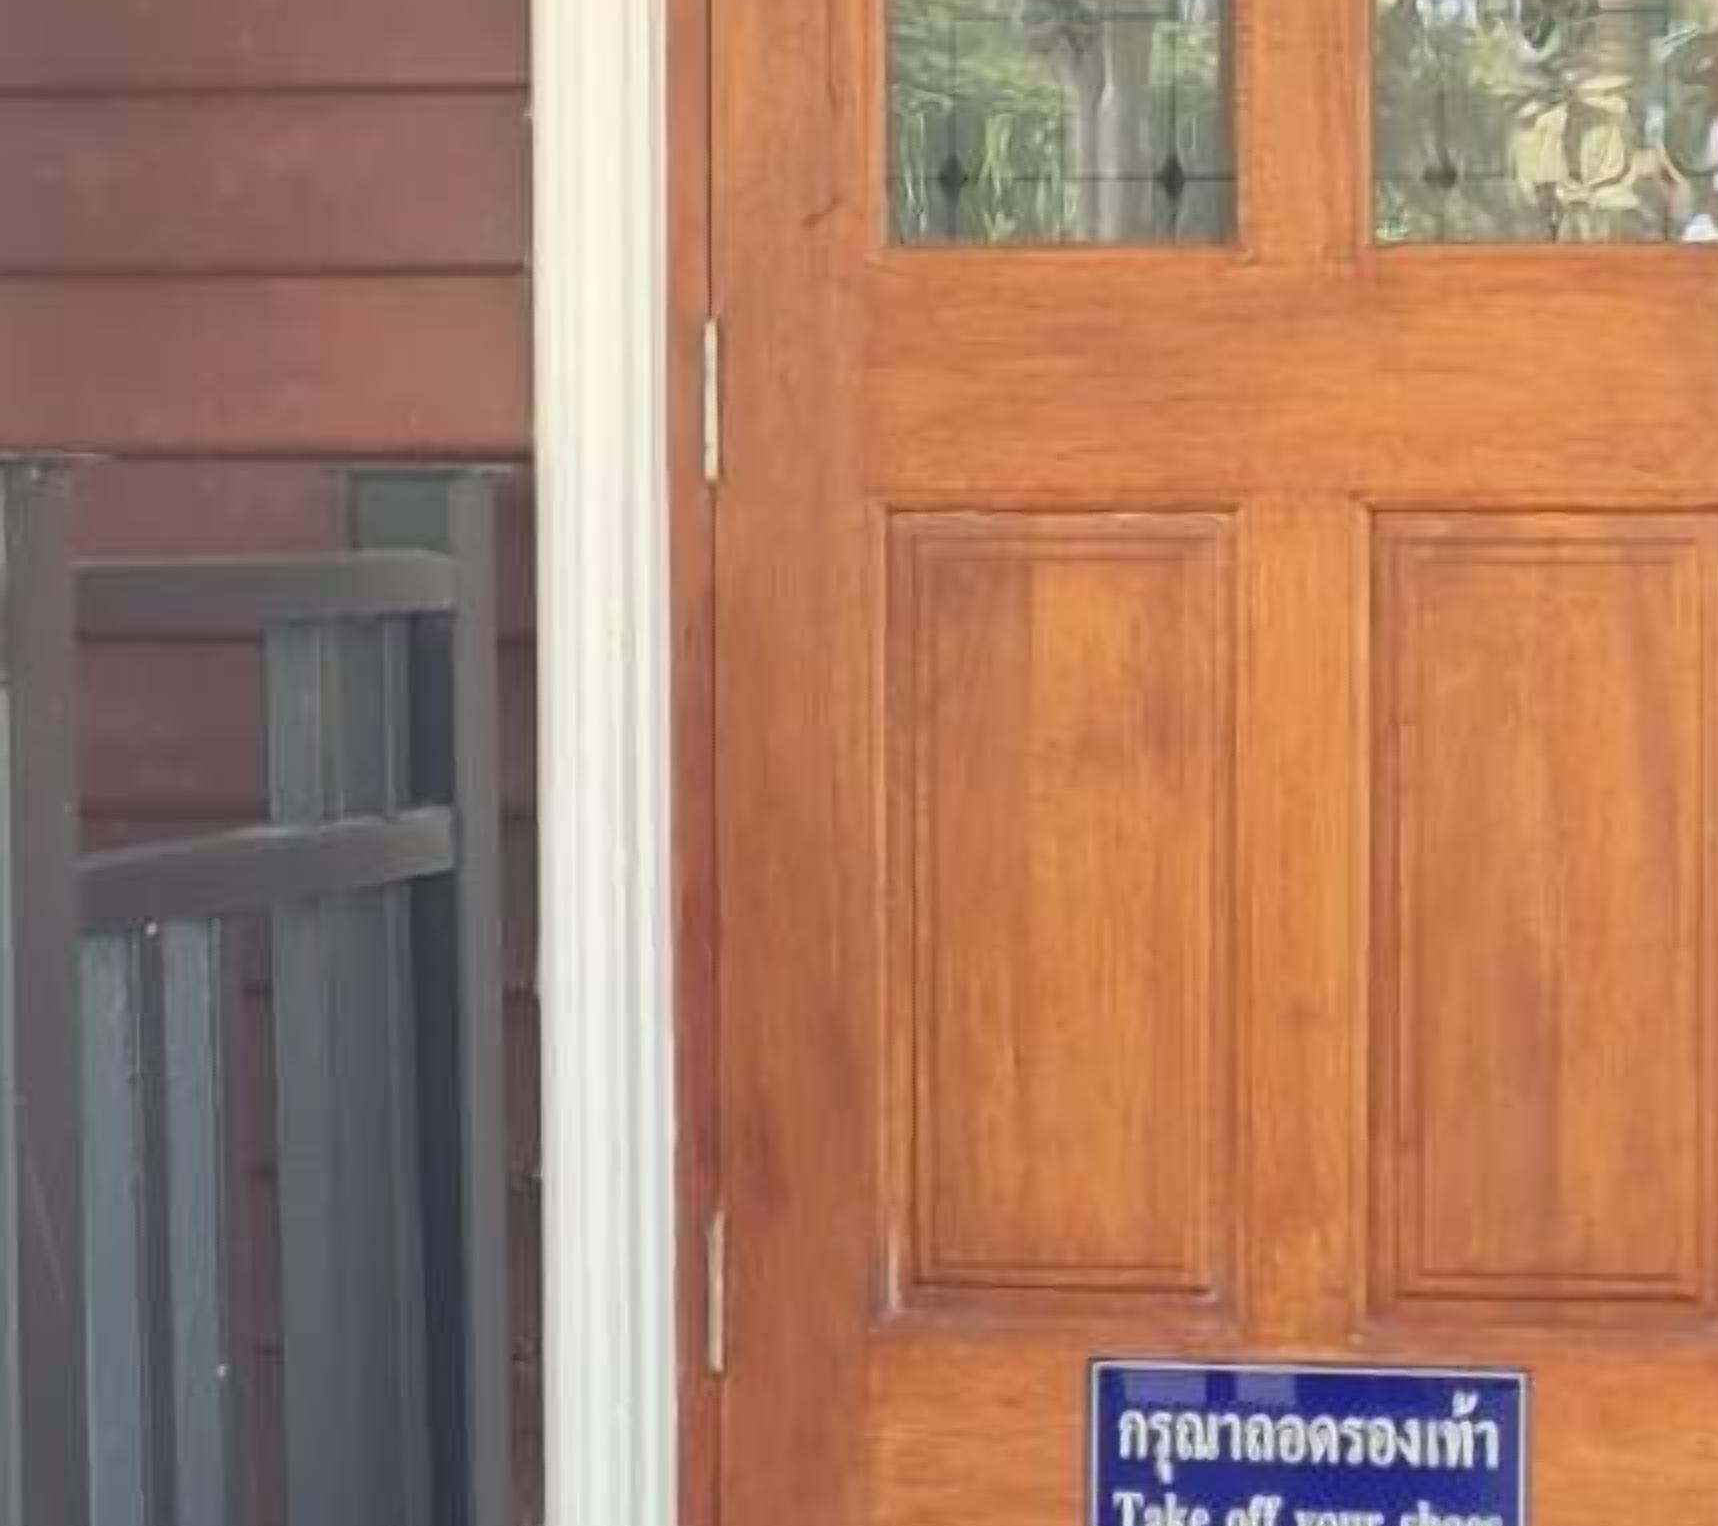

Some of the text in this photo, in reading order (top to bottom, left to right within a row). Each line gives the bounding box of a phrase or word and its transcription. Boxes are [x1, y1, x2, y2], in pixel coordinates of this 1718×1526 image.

[1117, 1390, 1500, 1484] กรุณาถอดรองเท้า
